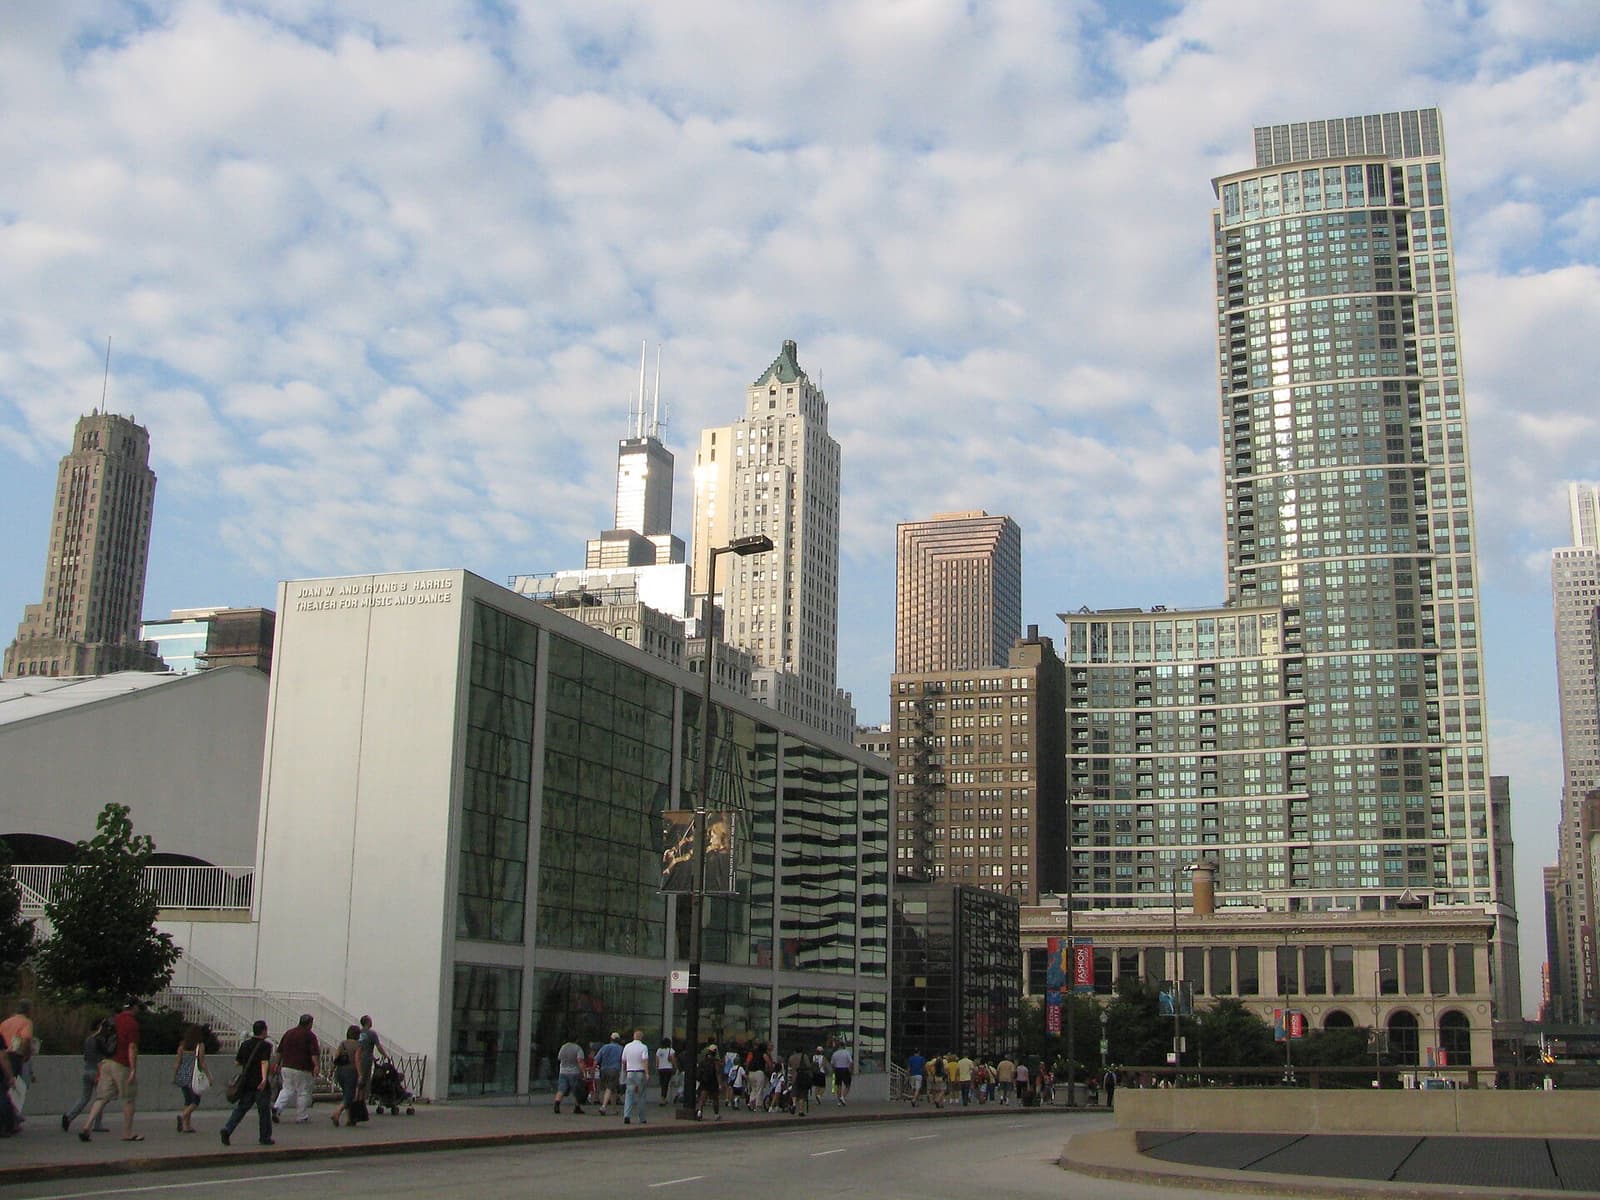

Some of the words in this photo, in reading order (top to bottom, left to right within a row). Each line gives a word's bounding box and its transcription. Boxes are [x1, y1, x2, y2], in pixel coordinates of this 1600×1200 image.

[297, 586, 321, 598] JOAN
[325, 586, 334, 597] W
[339, 585, 359, 595] AND
[362, 582, 397, 594] IRVING
[414, 578, 452, 591] HARRIS
[296, 600, 336, 612] THEATER
[340, 599, 358, 609] FOR
[361, 597, 392, 608] MUSIC
[395, 595, 415, 606] AND
[418, 592, 451, 604] DANCE
[1077, 948, 1085, 982] FASHION
[1583, 935, 1592, 998] ORIENTAL
